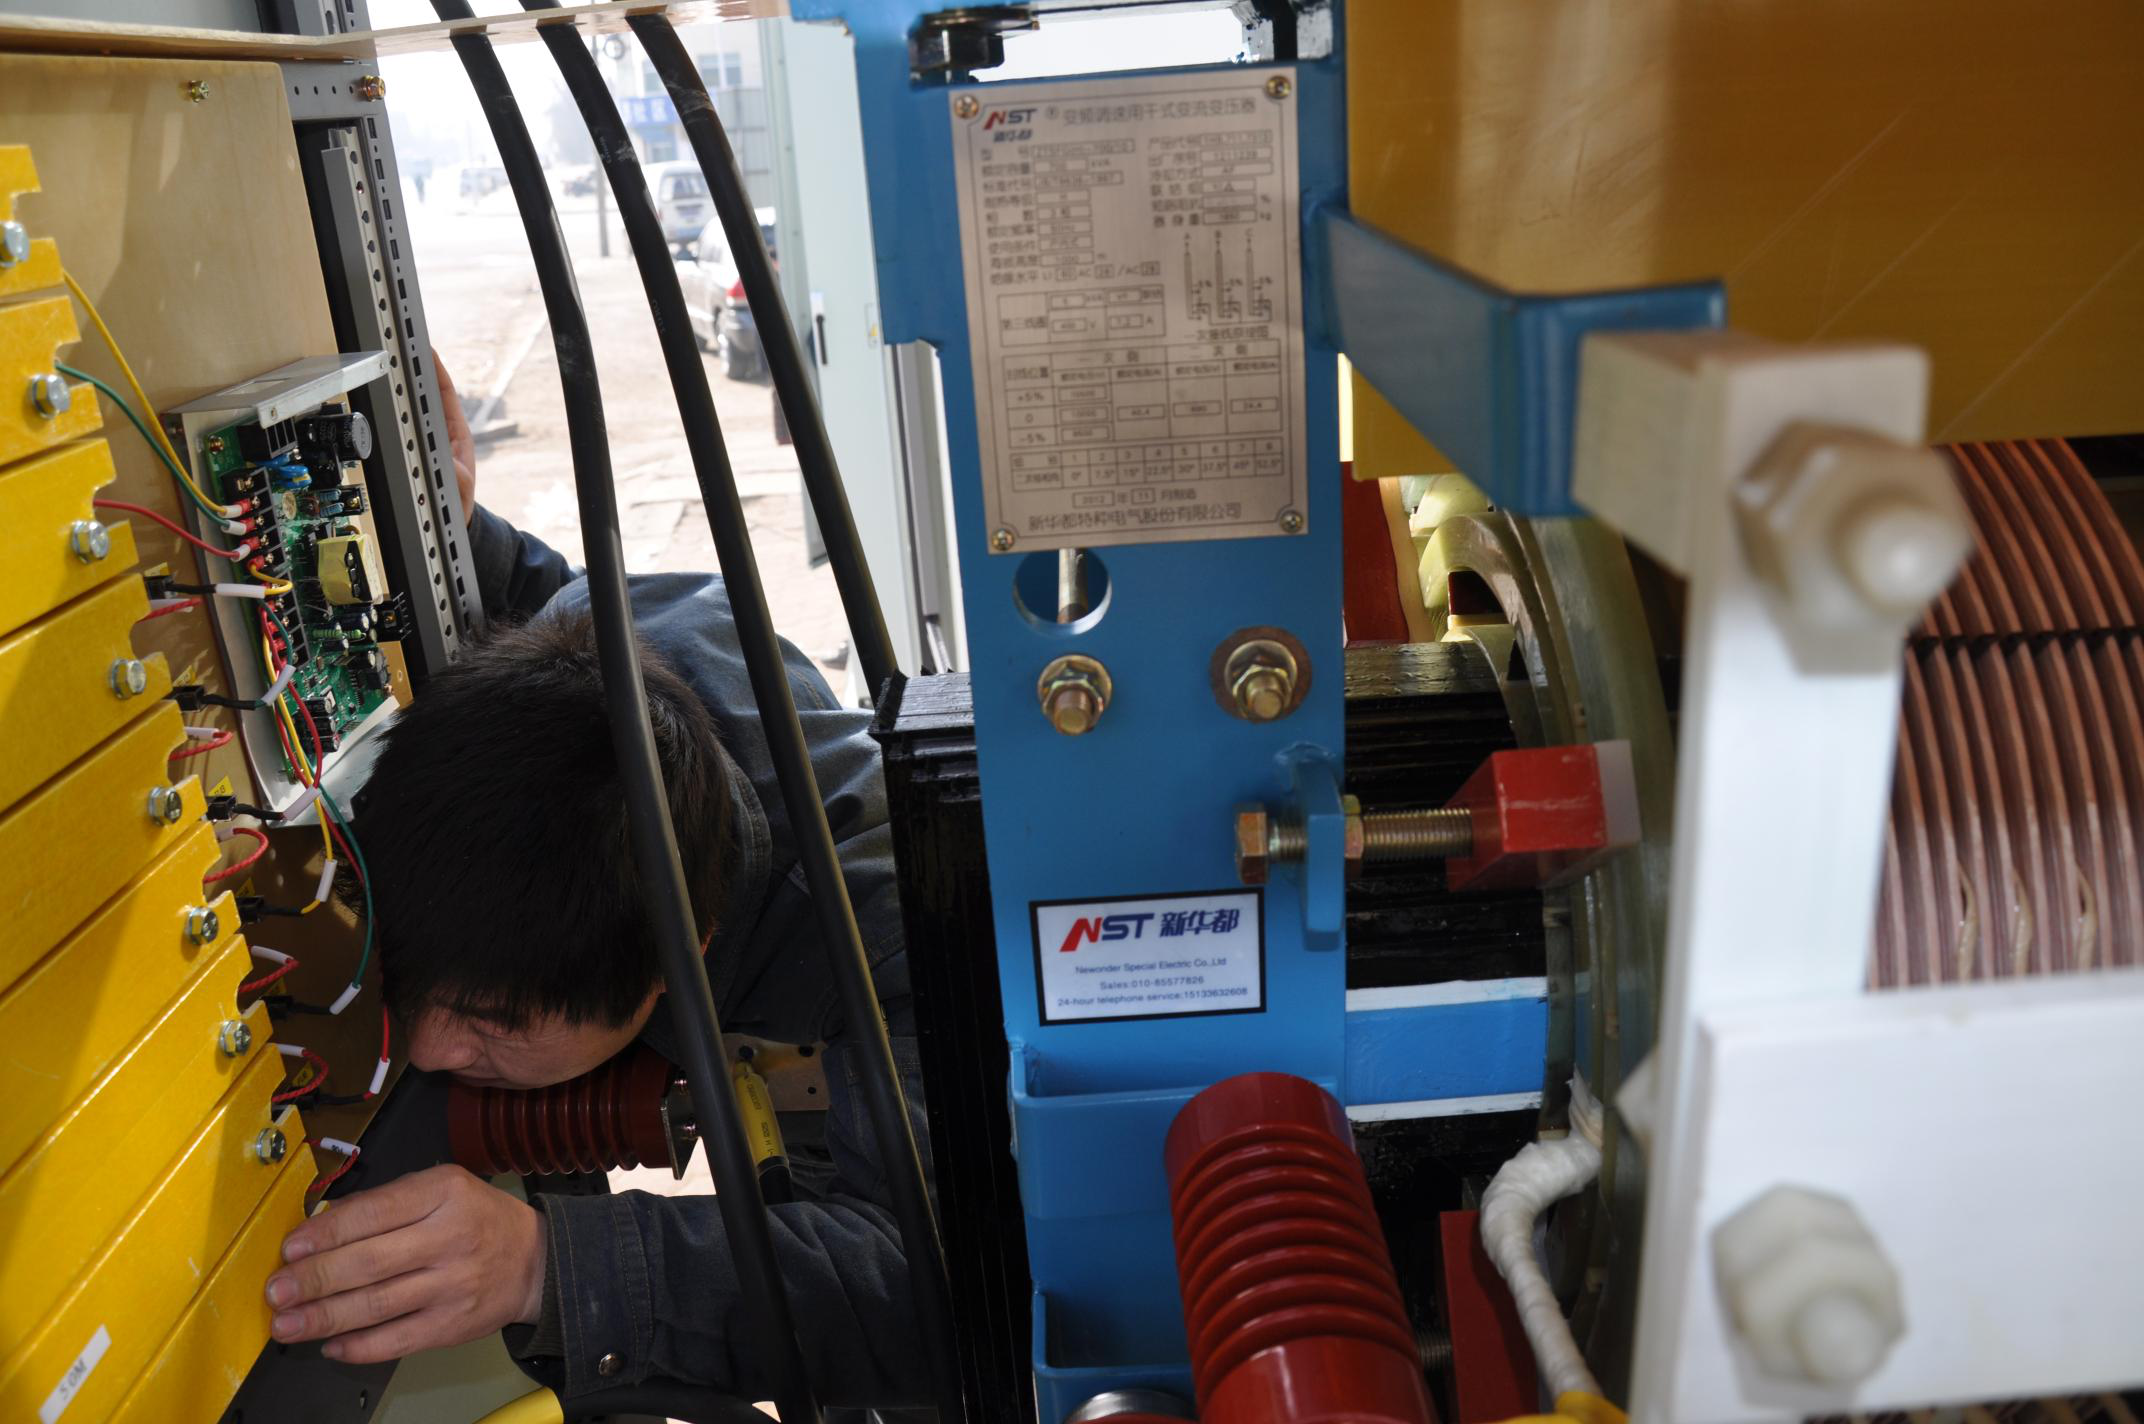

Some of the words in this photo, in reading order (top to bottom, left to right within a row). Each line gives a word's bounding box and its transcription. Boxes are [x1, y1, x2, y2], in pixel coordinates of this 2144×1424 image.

[982, 107, 1039, 130] NST
[1059, 912, 1155, 952] NST
[1159, 908, 1240, 938] 新华都
[1075, 963, 1121, 975] Newonder
[1124, 961, 1157, 973] Special
[1159, 959, 1192, 971] Electric
[1058, 997, 1094, 1007] 24-hour
[1097, 993, 1144, 1005] telephone
